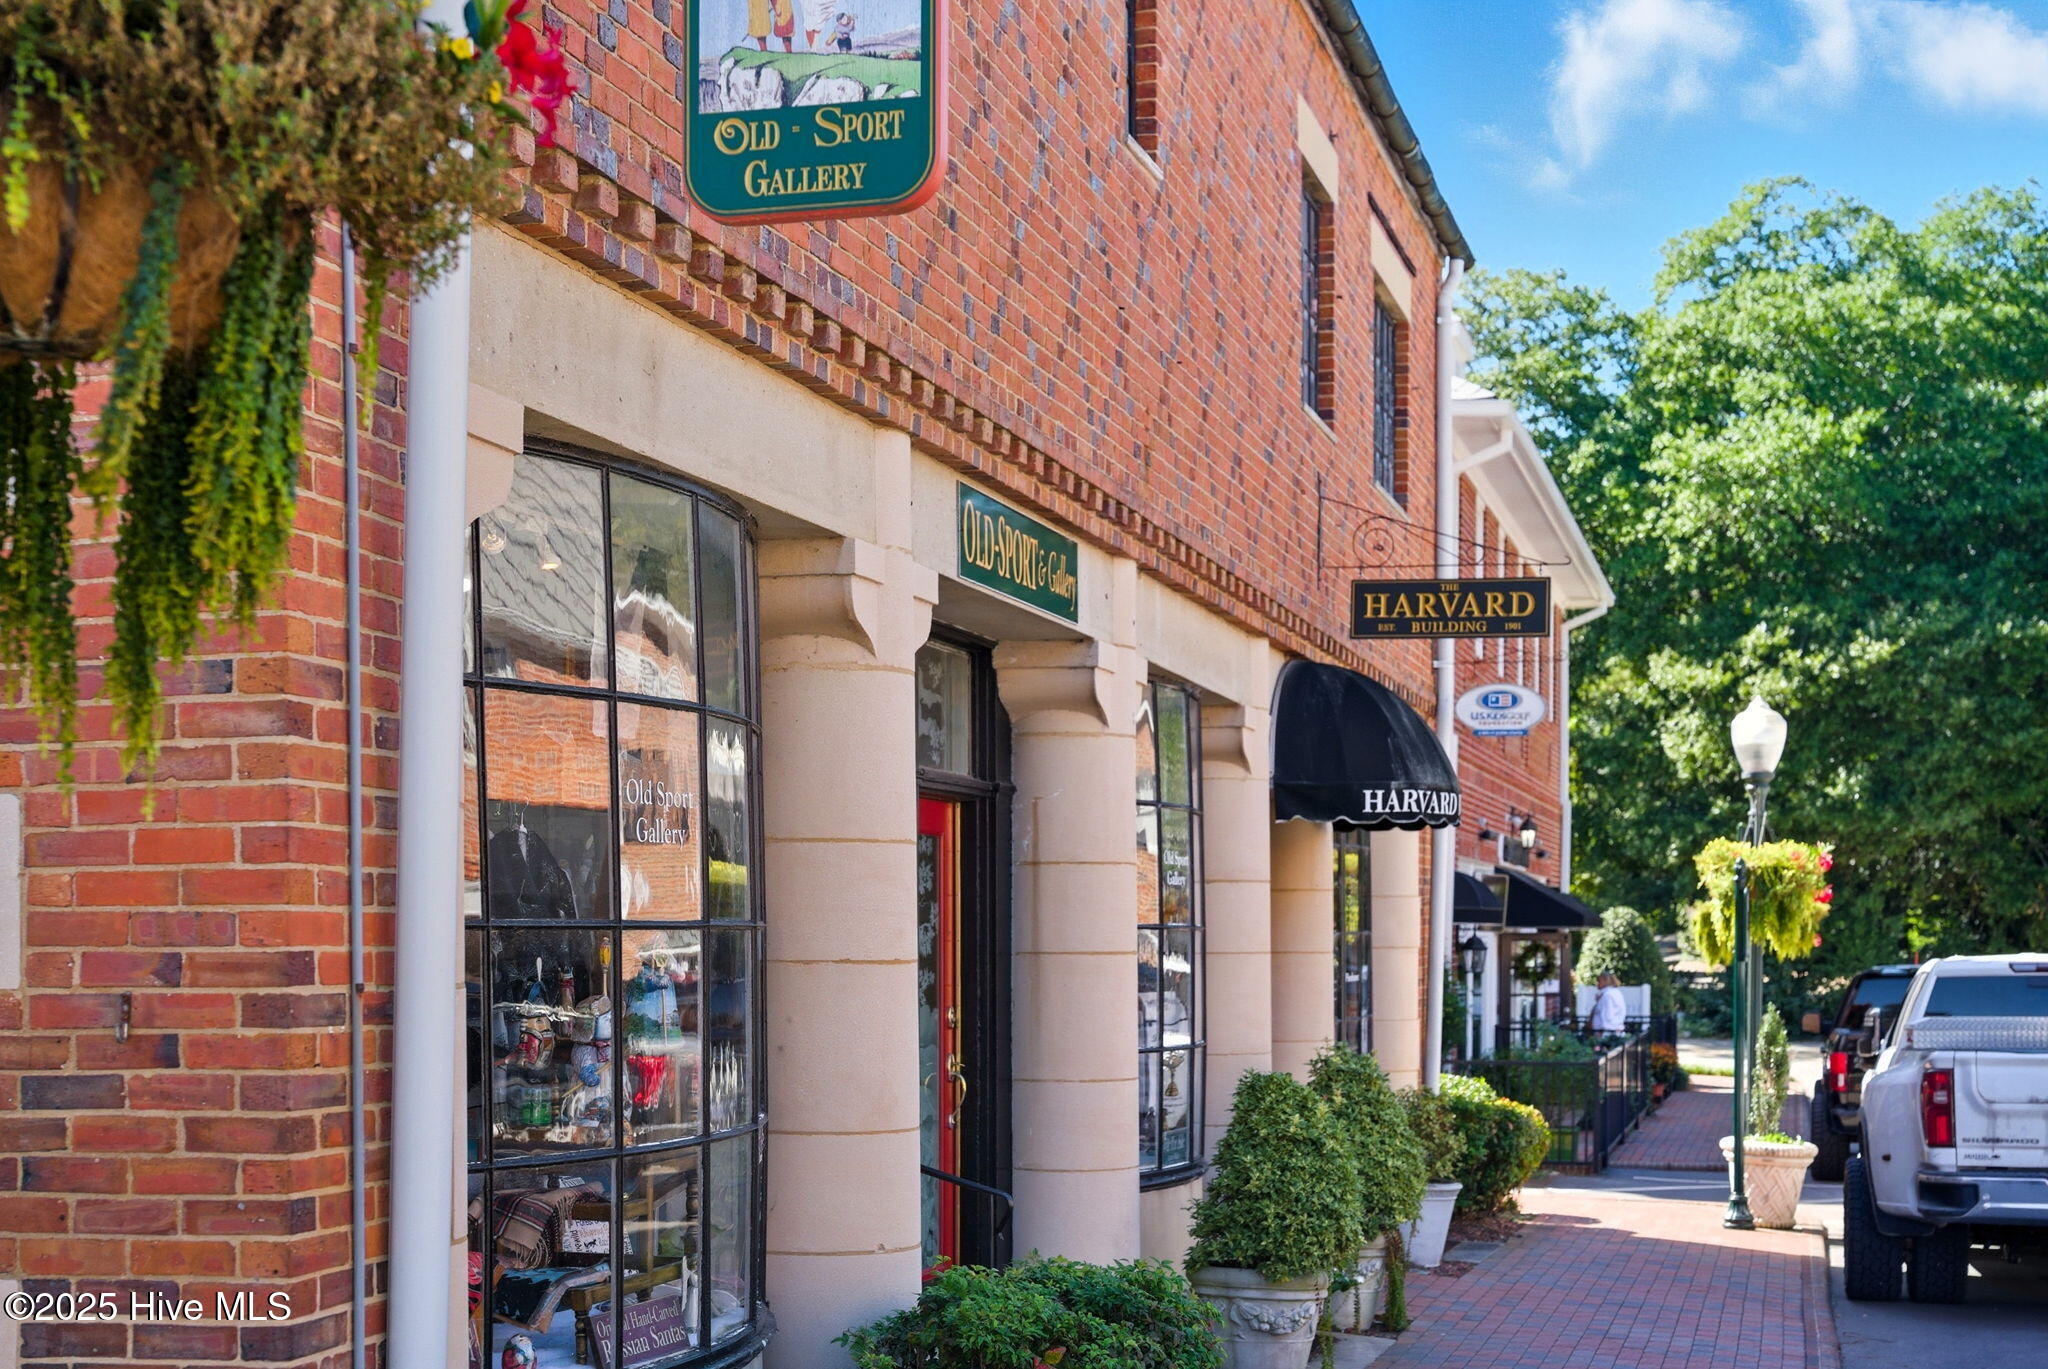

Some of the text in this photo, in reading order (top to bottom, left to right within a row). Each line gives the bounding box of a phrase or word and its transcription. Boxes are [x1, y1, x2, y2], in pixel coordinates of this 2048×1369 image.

[713, 117, 781, 156] OLD
[813, 106, 905, 148] SPORT
[744, 159, 867, 198] GALLERY
[1048, 551, 1077, 612] Gallery
[1440, 583, 1459, 592] THE
[1363, 591, 1536, 619] HARVARD
[1411, 620, 1487, 633] BUILDING
[626, 778, 695, 813] Old Sport
[1362, 789, 1458, 816] HARVARD
[636, 817, 686, 851] Gallery
[649, 1325, 687, 1349] Santas
